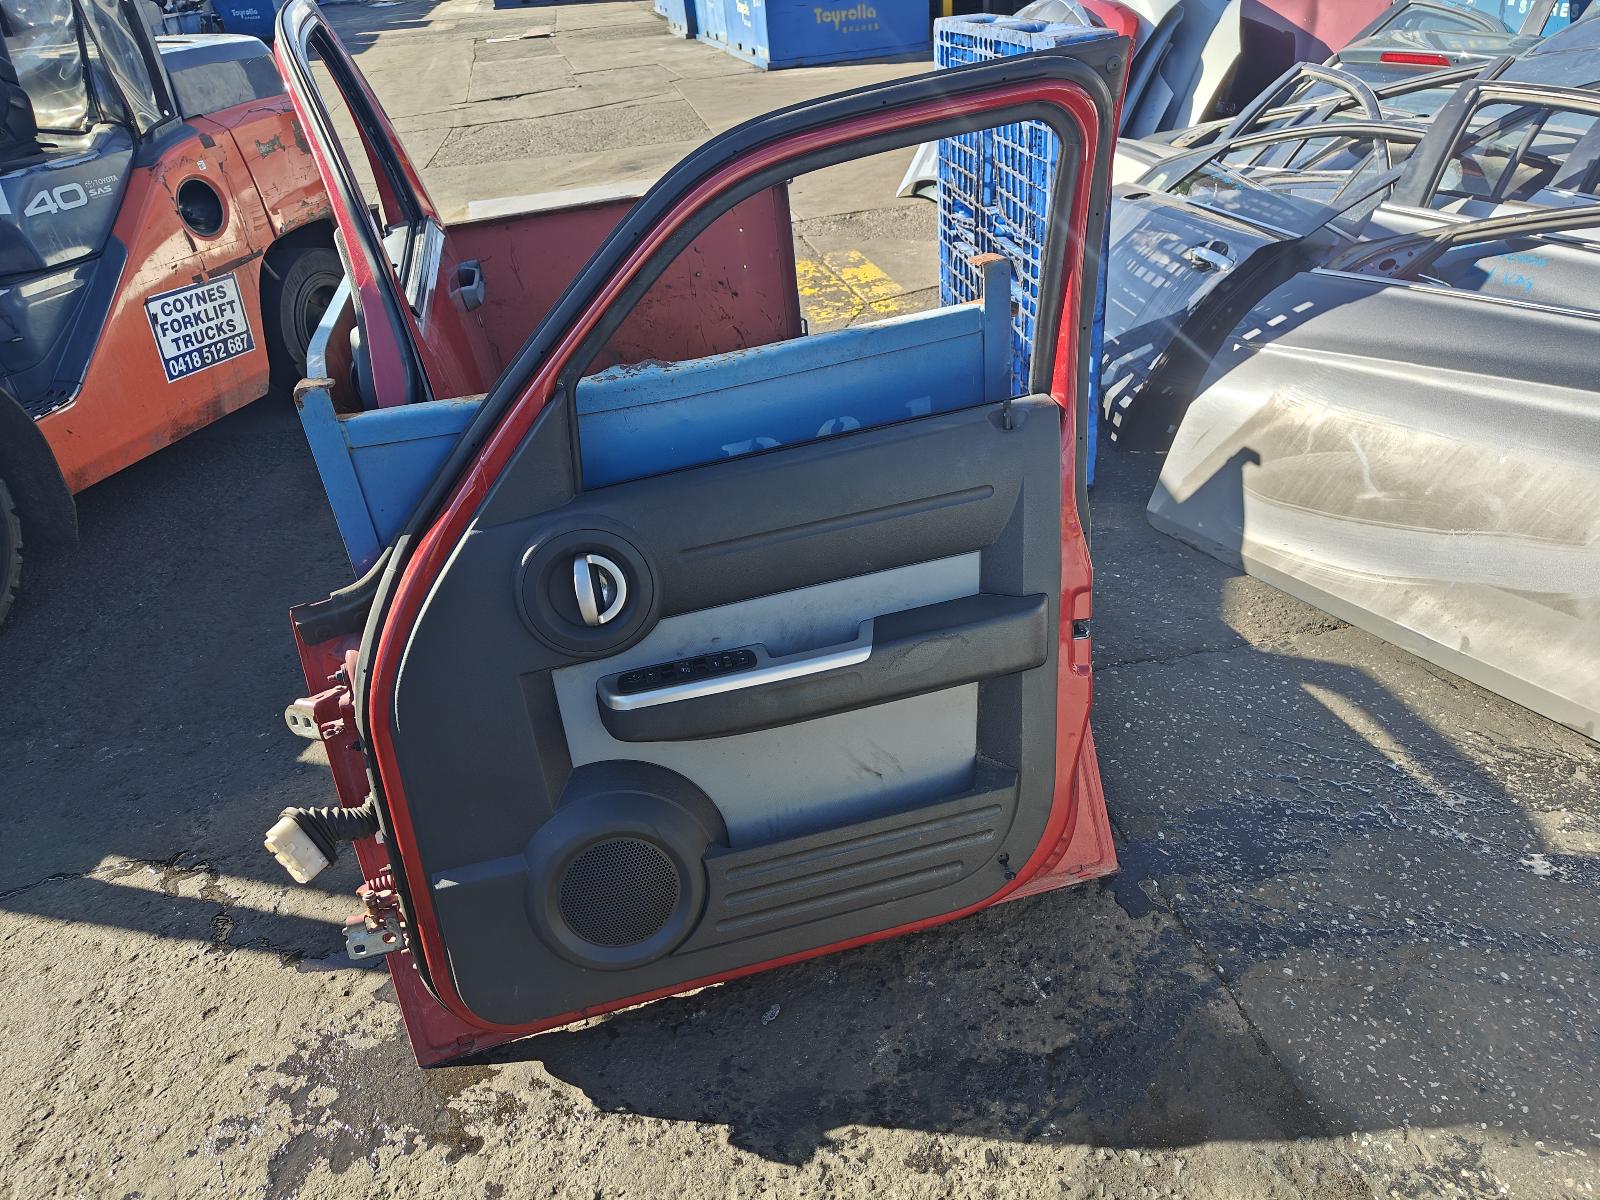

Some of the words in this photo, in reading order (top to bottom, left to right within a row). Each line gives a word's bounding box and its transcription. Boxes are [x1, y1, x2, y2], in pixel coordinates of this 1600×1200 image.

[814, 4, 877, 31] Toyrolla
[88, 185, 113, 197] SAS
[95, 174, 119, 186] TOYOTA
[23, 182, 88, 217] 40
[161, 284, 227, 317] COYNES
[159, 299, 236, 338] FORKLIFT
[171, 318, 237, 352] TRUCKS
[169, 352, 202, 376] 0418
[203, 342, 227, 364] 512
[228, 333, 249, 354] 687
